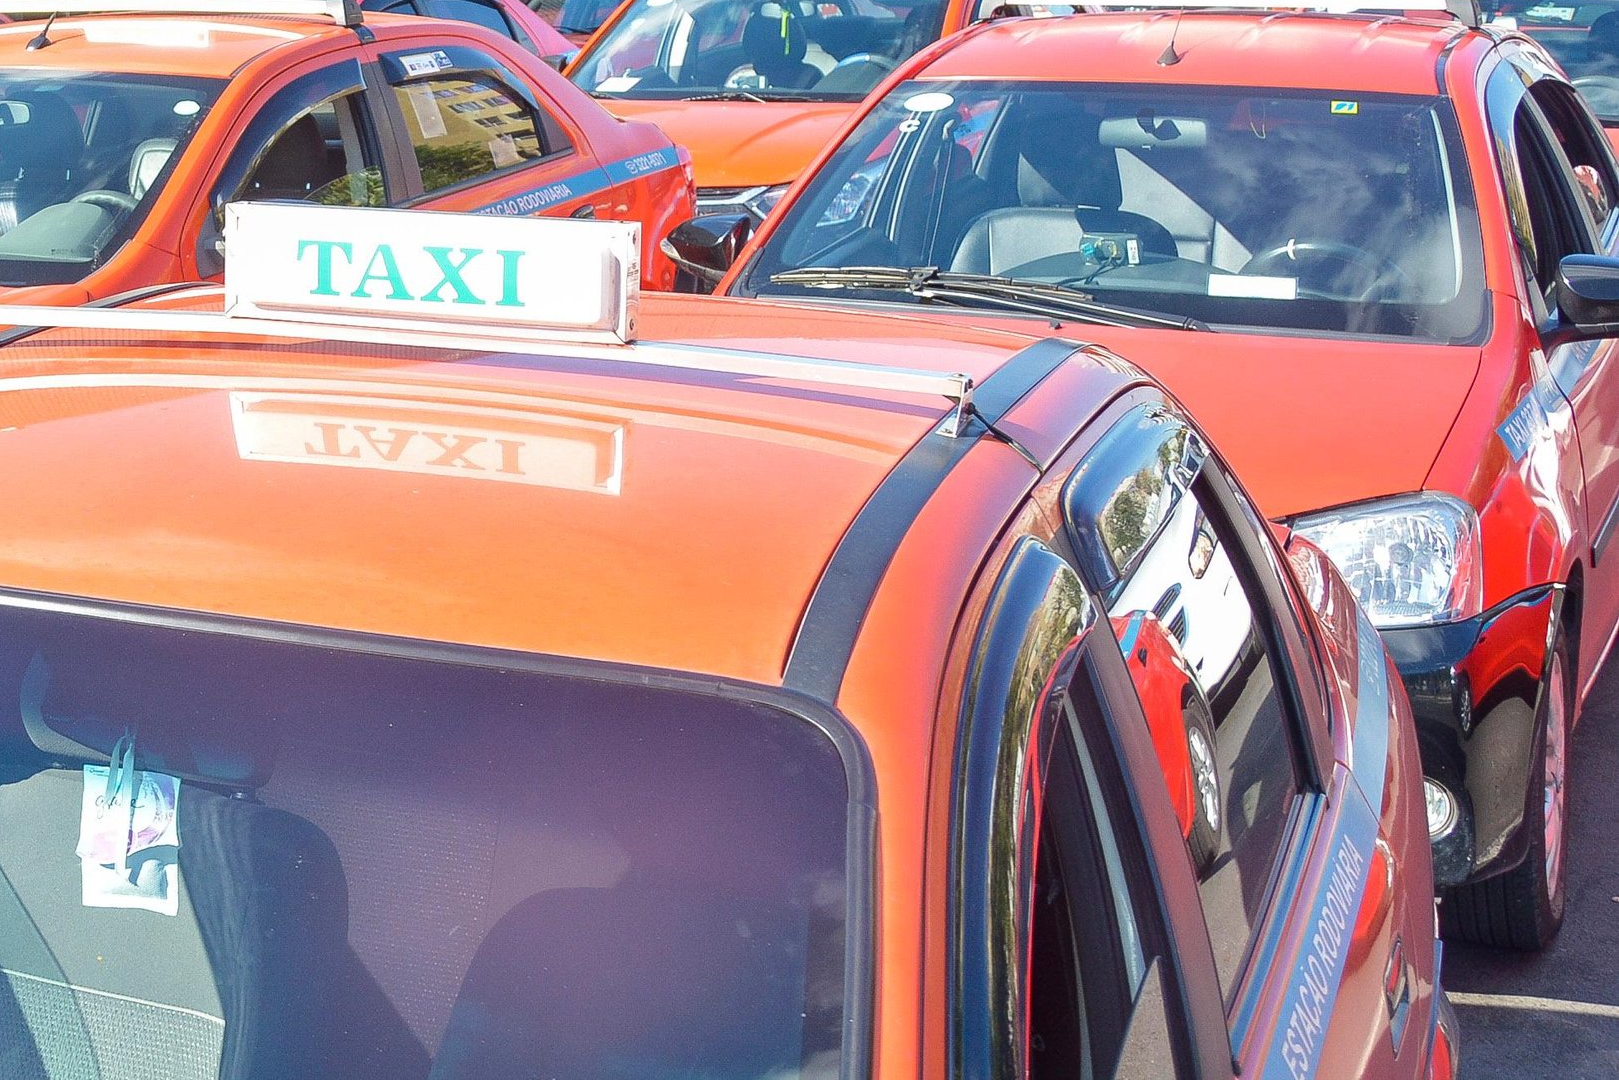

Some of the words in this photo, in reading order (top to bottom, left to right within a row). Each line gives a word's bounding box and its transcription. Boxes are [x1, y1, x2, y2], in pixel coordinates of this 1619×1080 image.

[517, 183, 572, 213] RODOVIÁRIA
[296, 239, 527, 308] TAXI
[1504, 415, 1531, 450] TAXI
[1312, 833, 1364, 971] RODOVIÁRIA
